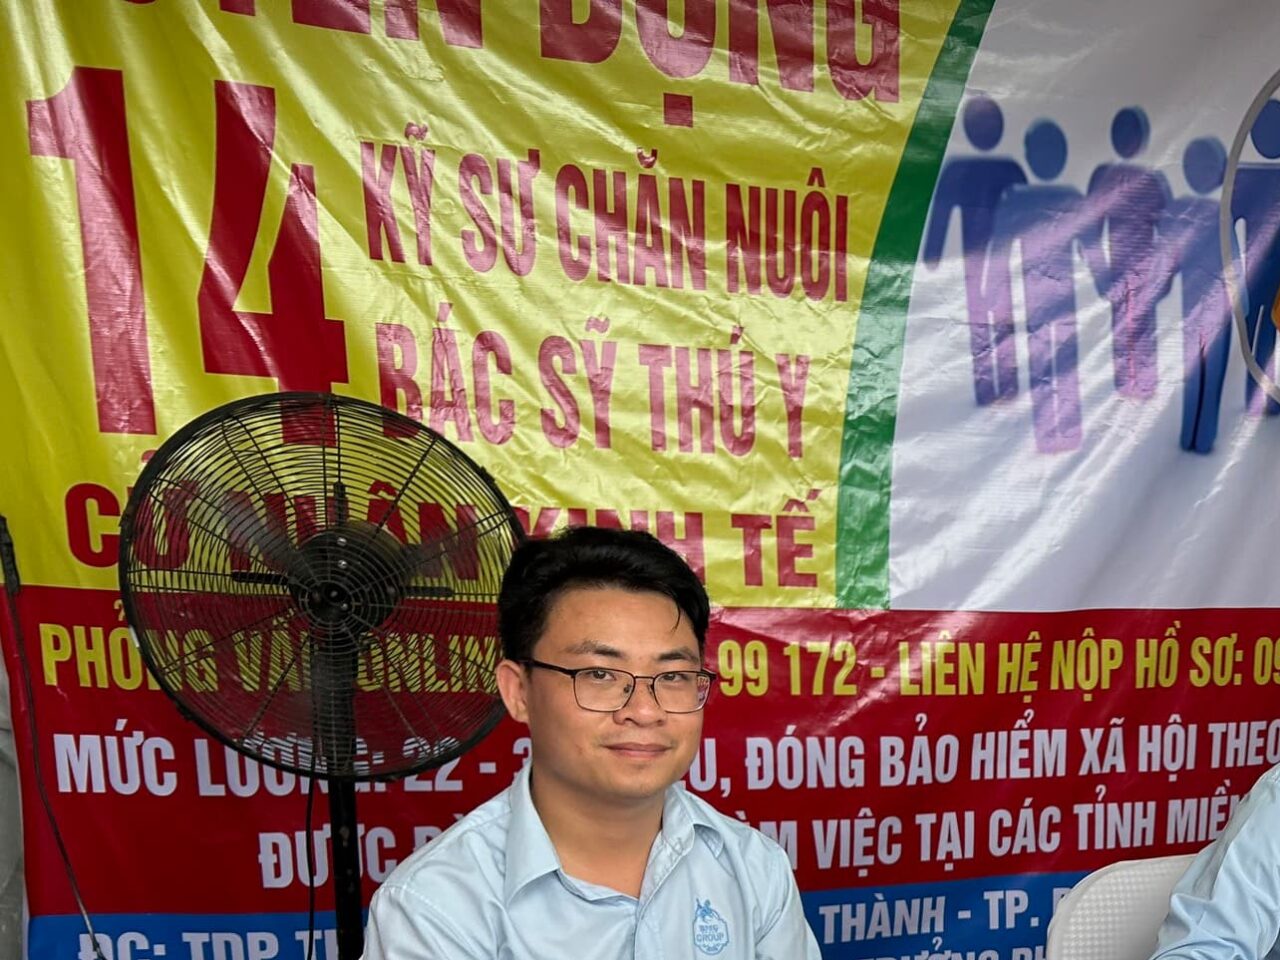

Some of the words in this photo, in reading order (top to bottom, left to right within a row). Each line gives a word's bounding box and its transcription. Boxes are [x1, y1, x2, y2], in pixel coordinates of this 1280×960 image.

[359, 122, 439, 267] KỸ
[458, 148, 541, 275] SƯ
[554, 146, 707, 290] CHĂN
[724, 167, 850, 302] NUÔI
[375, 302, 518, 447] BÁC
[539, 316, 620, 449] SỸ
[639, 326, 754, 456] THÚ
[775, 353, 811, 458] Y
[731, 490, 819, 587] TẾ
[360, 631, 500, 693] ONLIN
[783, 640, 858, 698] 172
[899, 629, 985, 696] LIÊN
[999, 631, 1041, 703] HỆ
[1050, 628, 1122, 701] NỘP
[1135, 620, 1182, 690] HỒ
[1190, 631, 1243, 687] SƠ:
[53, 719, 178, 796] MỨC
[745, 725, 865, 791] ĐÓNG
[880, 713, 960, 784] BẢO
[971, 708, 1068, 780] HIỂM
[1079, 718, 1126, 775] XÃ
[1137, 714, 1197, 782] HỘI
[259, 824, 398, 889] ĐƯC
[812, 807, 903, 878] VIỆC
[916, 811, 975, 875] TẠI
[988, 798, 1061, 854] CÁC
[1073, 783, 1156, 851] TỈNH
[819, 889, 946, 944] THÀNH
[984, 889, 1039, 929] TP.
